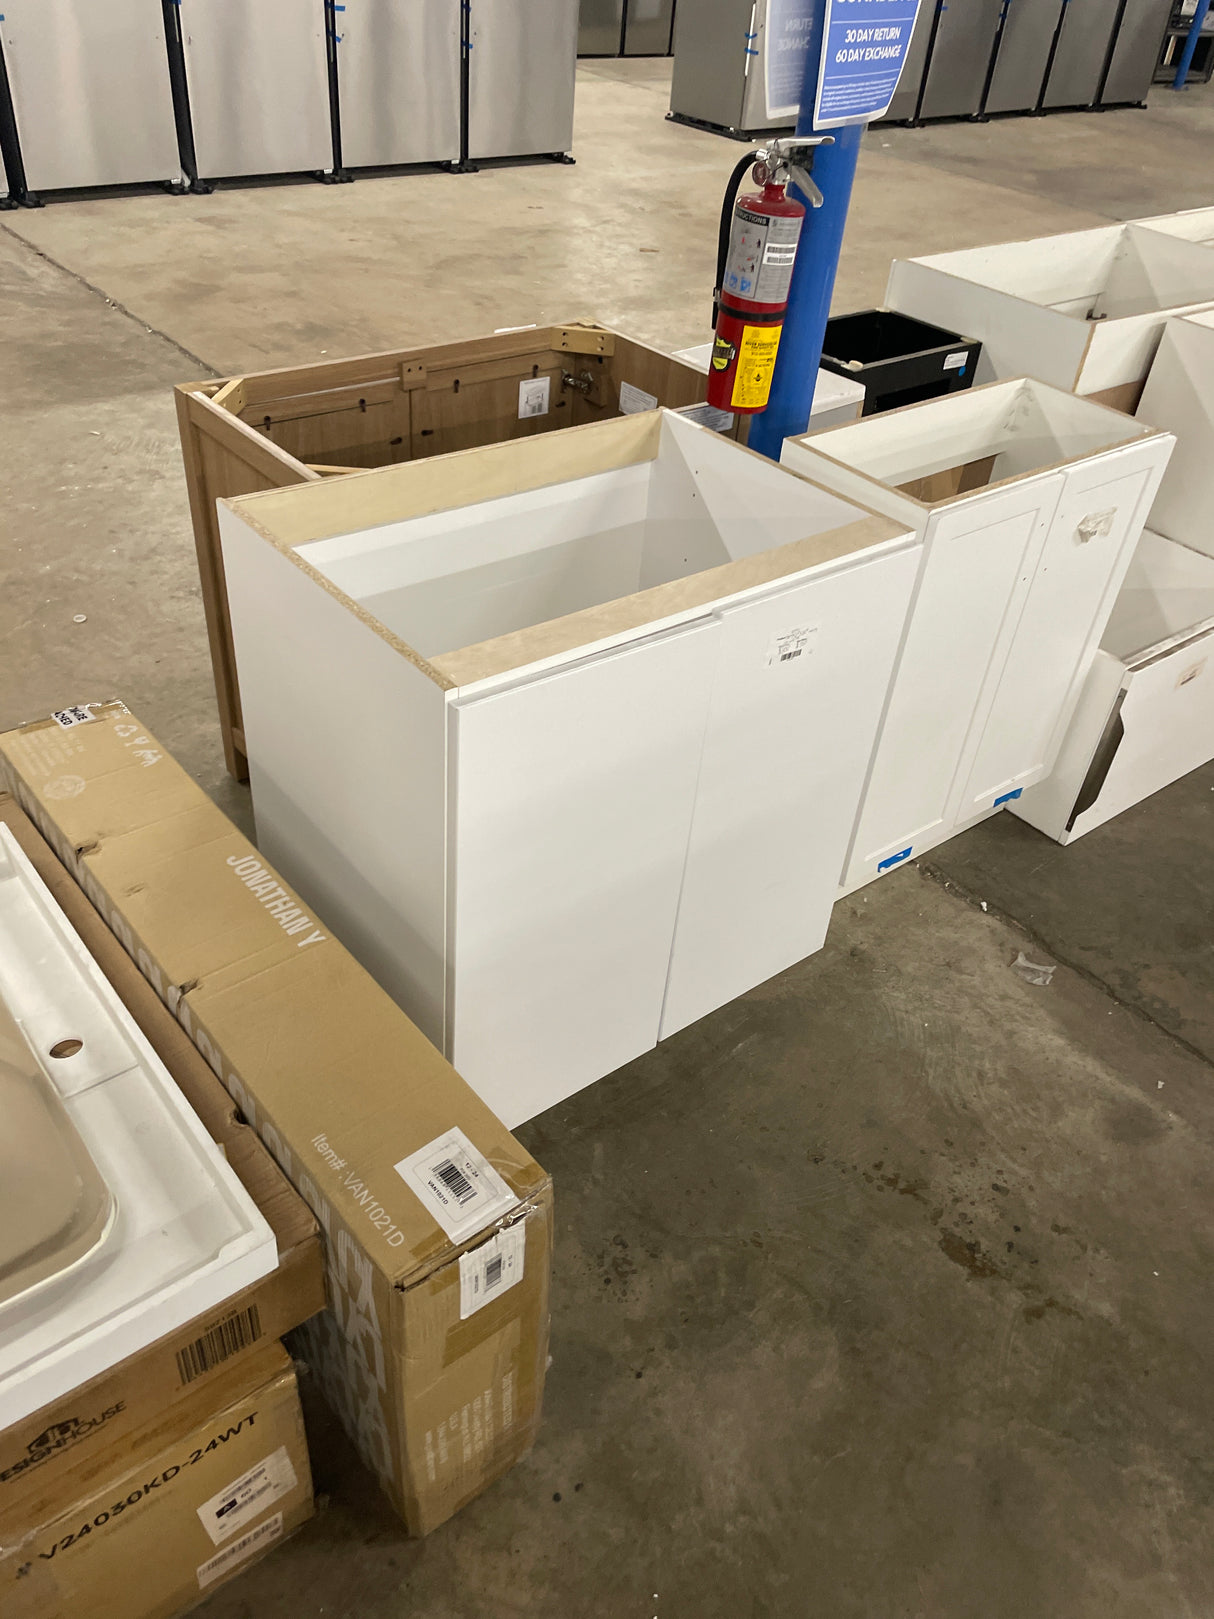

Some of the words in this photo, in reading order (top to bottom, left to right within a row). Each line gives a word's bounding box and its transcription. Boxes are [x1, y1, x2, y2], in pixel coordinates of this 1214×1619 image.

[835, 48, 848, 63] 60
[847, 47, 866, 62] DAY
[864, 44, 902, 61] EXCHANGE
[844, 29, 857, 43] 30
[856, 28, 875, 42] DAY
[873, 26, 902, 41] RETURN
[226, 855, 314, 936] JONATHAN
[297, 929, 327, 947] Y
[0, 1400, 127, 1481] ESIGNHOUSE
[38, 1411, 259, 1560] V24030KD-24WT
